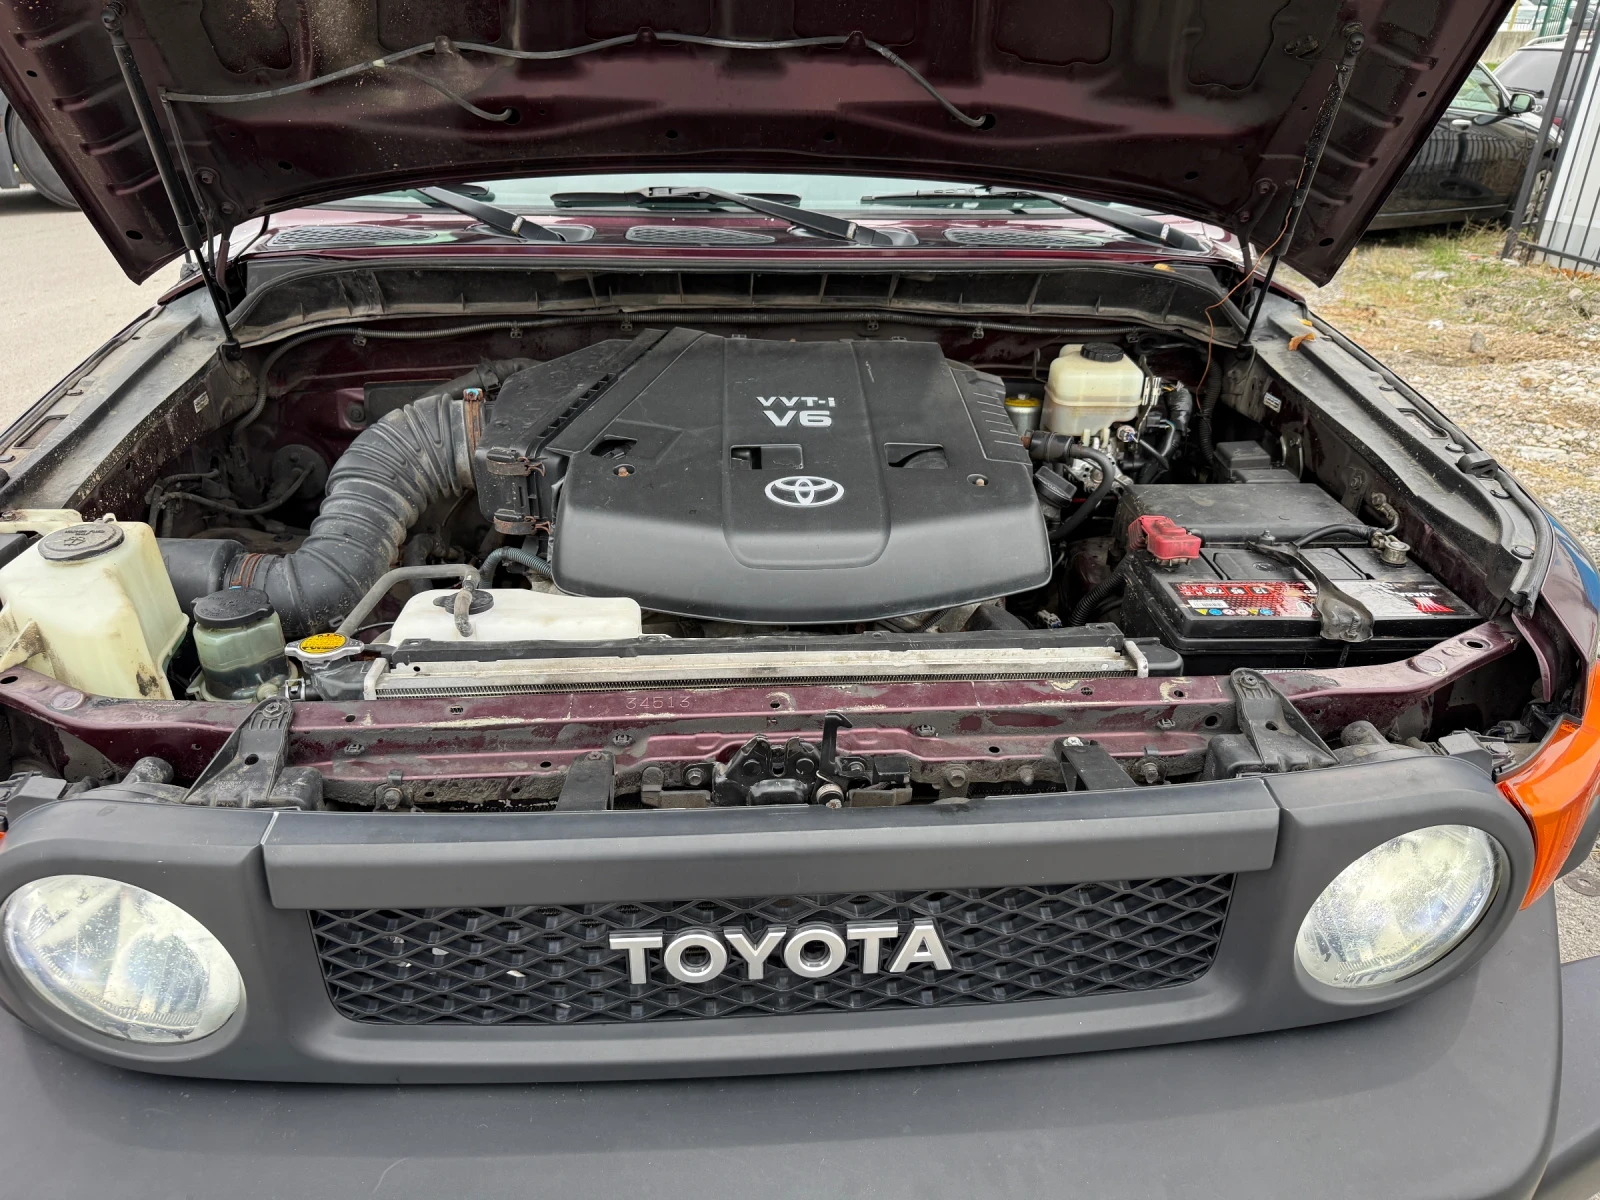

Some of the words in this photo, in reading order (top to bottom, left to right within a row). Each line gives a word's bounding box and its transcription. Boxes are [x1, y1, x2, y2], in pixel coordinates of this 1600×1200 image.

[756, 396, 836, 407] VVT-i
[762, 410, 832, 427] V6
[625, 696, 691, 710] 34513
[608, 918, 952, 985] TOYOTA
